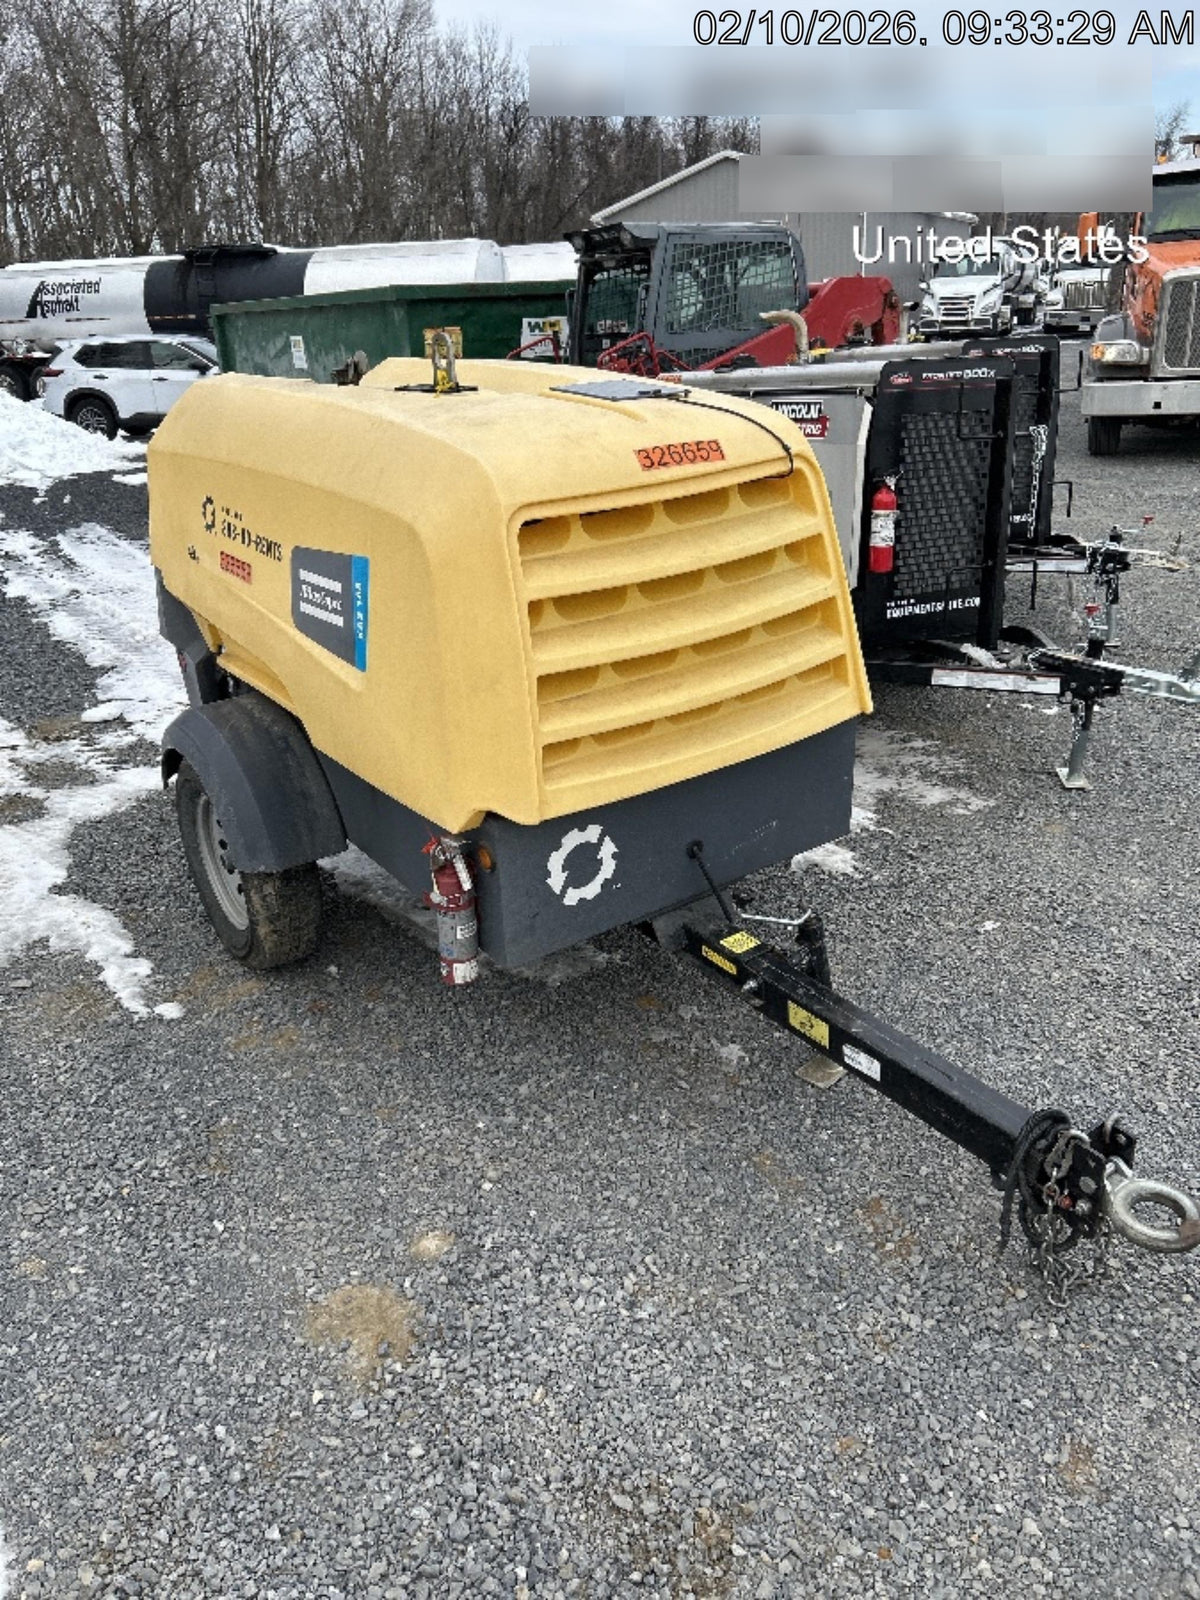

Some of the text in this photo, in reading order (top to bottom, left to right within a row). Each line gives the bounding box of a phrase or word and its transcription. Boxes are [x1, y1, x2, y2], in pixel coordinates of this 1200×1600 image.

[30, 277, 102, 300] Associated
[24, 294, 80, 318] Asphalt
[637, 440, 725, 468] 326659
